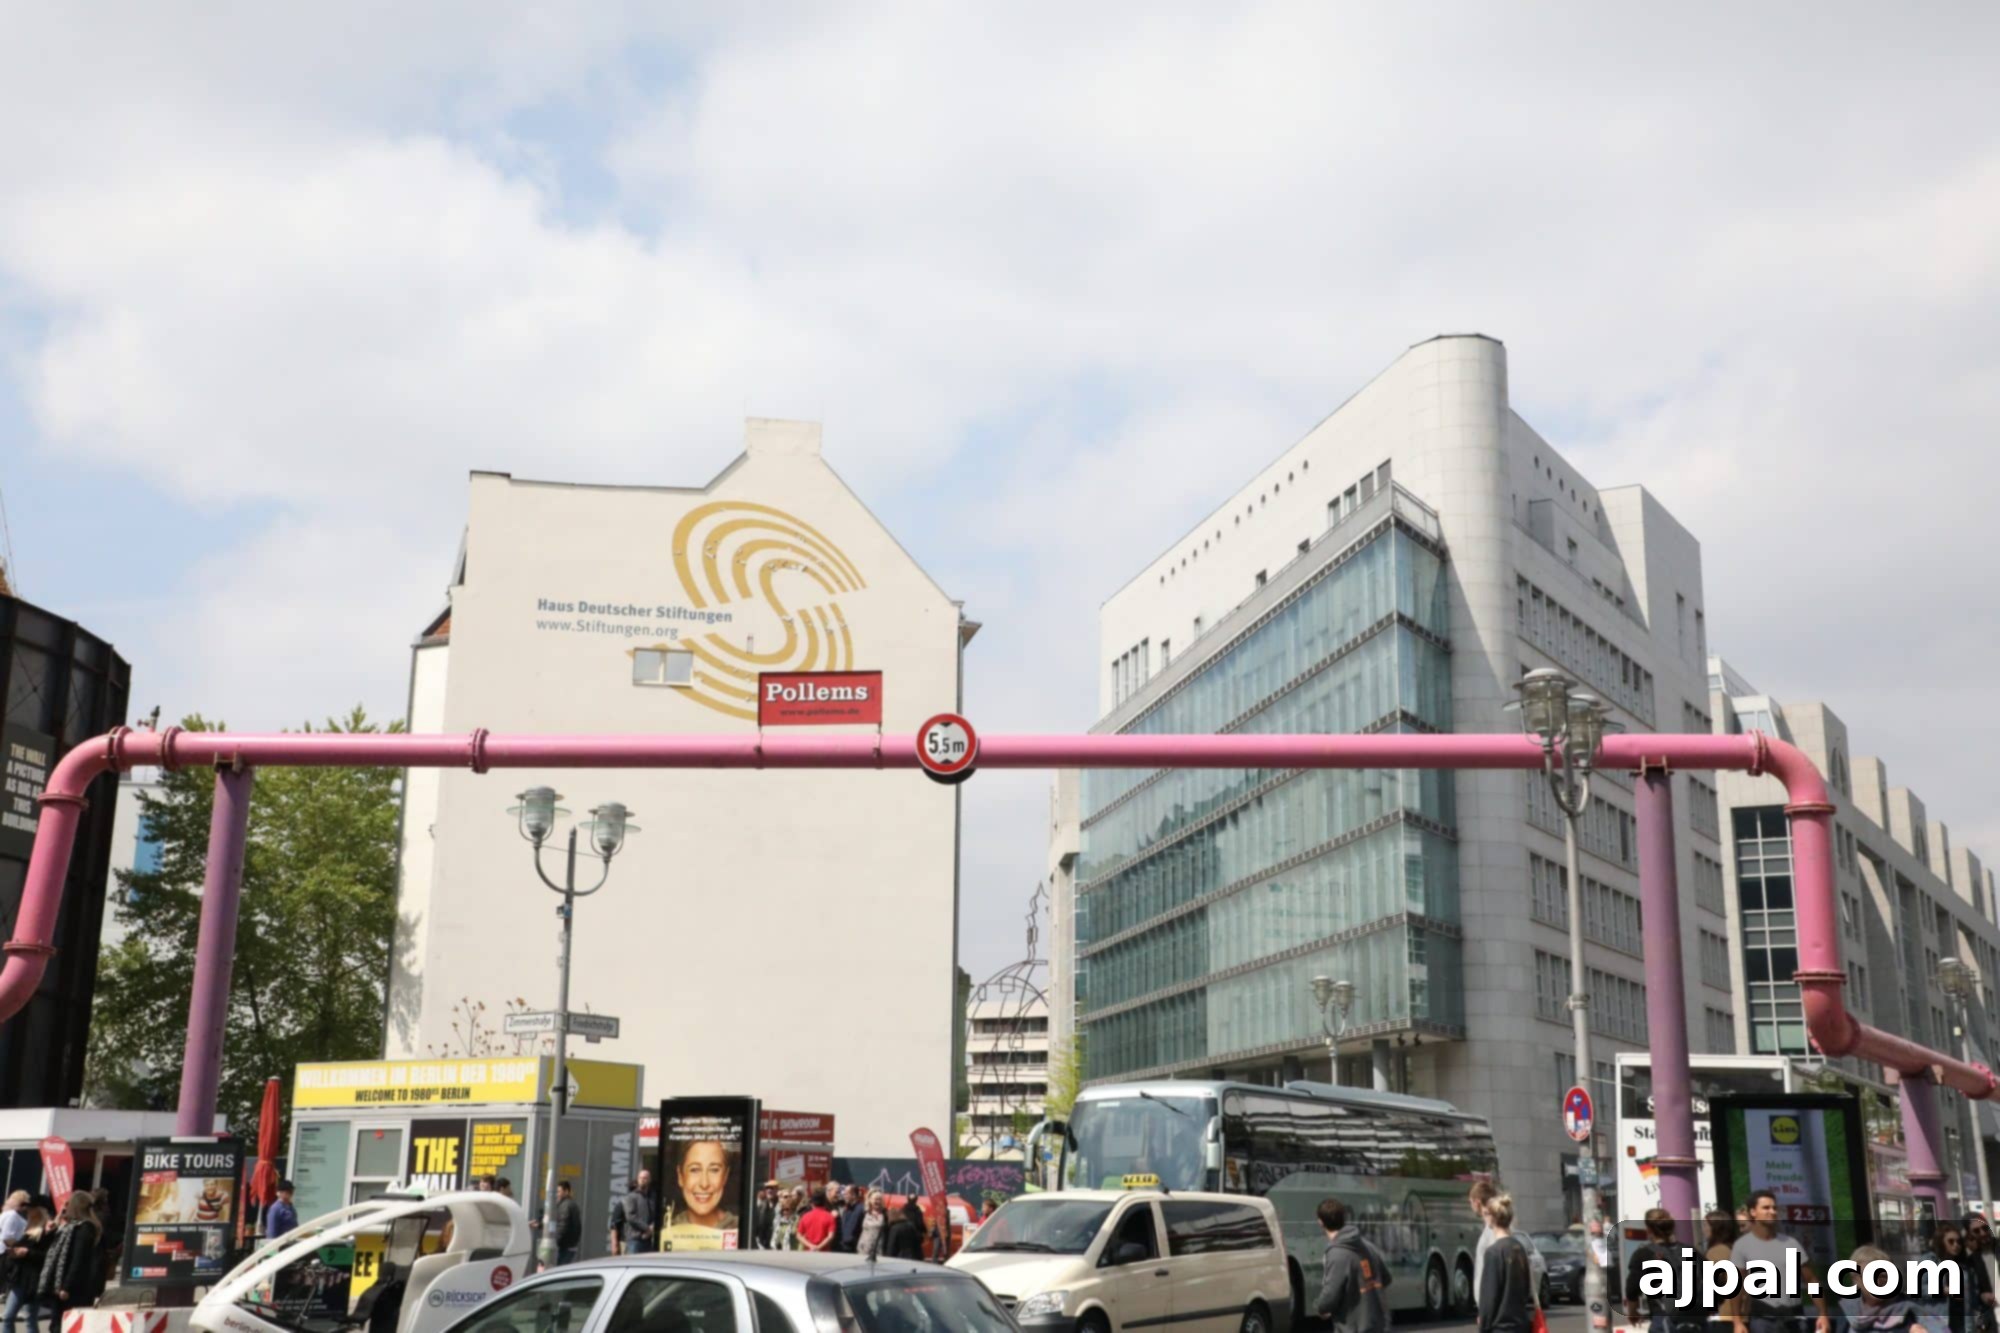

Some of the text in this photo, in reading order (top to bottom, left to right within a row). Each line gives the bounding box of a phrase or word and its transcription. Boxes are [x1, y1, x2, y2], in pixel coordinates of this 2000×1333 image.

[537, 598, 733, 625] Haus Deutscher Stiftungen
[536, 619, 680, 640] www.Stiftungen.org
[765, 682, 869, 702] Pollems
[780, 707, 860, 716] www.pollems.de
[928, 732, 965, 755] 5,5 m
[11, 743, 46, 767] THE WALL
[6, 760, 46, 784] A PICTURE
[5, 777, 17, 793] AS
[17, 780, 32, 798] BIG
[13, 796, 32, 815] THIS
[299, 1068, 387, 1089] WILLKOMMEN
[390, 1066, 407, 1086] IM
[411, 1065, 458, 1085] BERLIN
[461, 1063, 487, 1084] DER
[355, 1088, 396, 1102] WELCOME
[397, 1088, 408, 1101] TO
[440, 1086, 471, 1100] BERLIN
[780, 1117, 821, 1131] SHOWROOM
[143, 1153, 235, 1169] BIKE TOURS
[413, 1138, 460, 1174] THE
[1765, 1161, 1793, 1170] Mehr
[1766, 1172, 1804, 1182] Freude
[1793, 1208, 1826, 1221] 2.59
[446, 1289, 487, 1303] RÜCKSICHT
